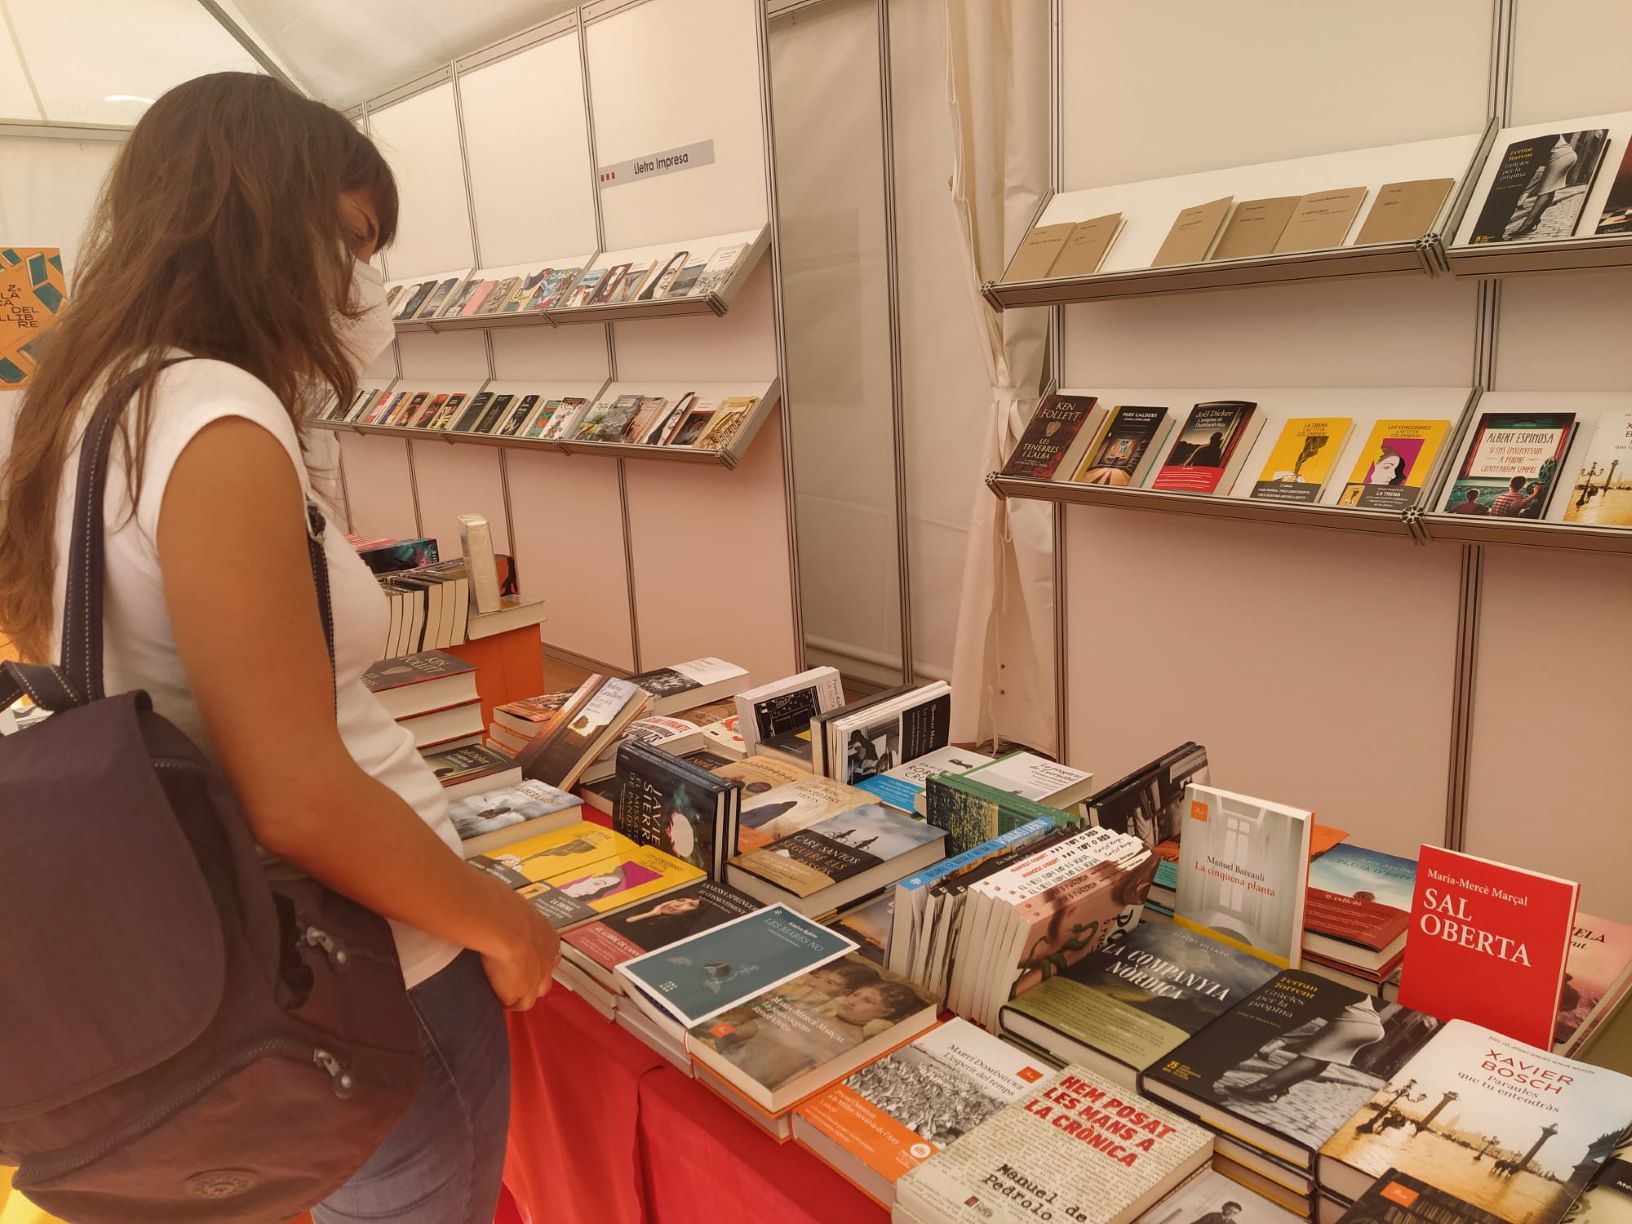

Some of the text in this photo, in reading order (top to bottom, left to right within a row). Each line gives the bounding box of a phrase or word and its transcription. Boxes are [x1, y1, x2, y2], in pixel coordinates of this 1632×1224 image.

[634, 153, 689, 175] Lletra Impresa
[11, 306, 39, 314] DEL
[1040, 408, 1084, 421] FOLLETT
[1056, 402, 1076, 410] KEN
[1211, 410, 1234, 418] Dicker
[1023, 444, 1060, 453] TENEBRES
[1486, 432, 1554, 444] ALBERT ESPINOSA
[642, 782, 653, 845] SIERR
[652, 788, 662, 845] JAVIE
[794, 835, 820, 849] CARE
[1195, 861, 1276, 896] La cinquena planta
[1207, 855, 1265, 882] Manuel Baixauli
[1423, 887, 1473, 922] SAL
[1427, 868, 1528, 907] Maria-Mercè Marçal
[1420, 913, 1532, 968] OBERTA
[1572, 926, 1606, 943] ELA
[1102, 943, 1232, 1002] LA COMPANYIA
[1106, 960, 1184, 1000] NÒRDICA
[1274, 981, 1316, 999] Torrent
[1280, 976, 1318, 992] Ferran
[1248, 1000, 1294, 1019] propina
[1256, 995, 1289, 1008] per la
[944, 1052, 1016, 1097] L'esperit del temps
[1481, 1060, 1563, 1095] BOSCH
[1486, 1049, 1575, 1086] XAVIER
[1458, 1070, 1561, 1114] que tu entendràs
[1488, 1075, 1540, 1098] Paraules
[1043, 1086, 1156, 1152] LES MANS A
[1060, 1075, 1176, 1140] HEM POSAT
[1024, 1099, 1138, 1168] LA CRÒNICA
[982, 1174, 1053, 1221] Pedrolo
[996, 1163, 1088, 1223] Manuel de
